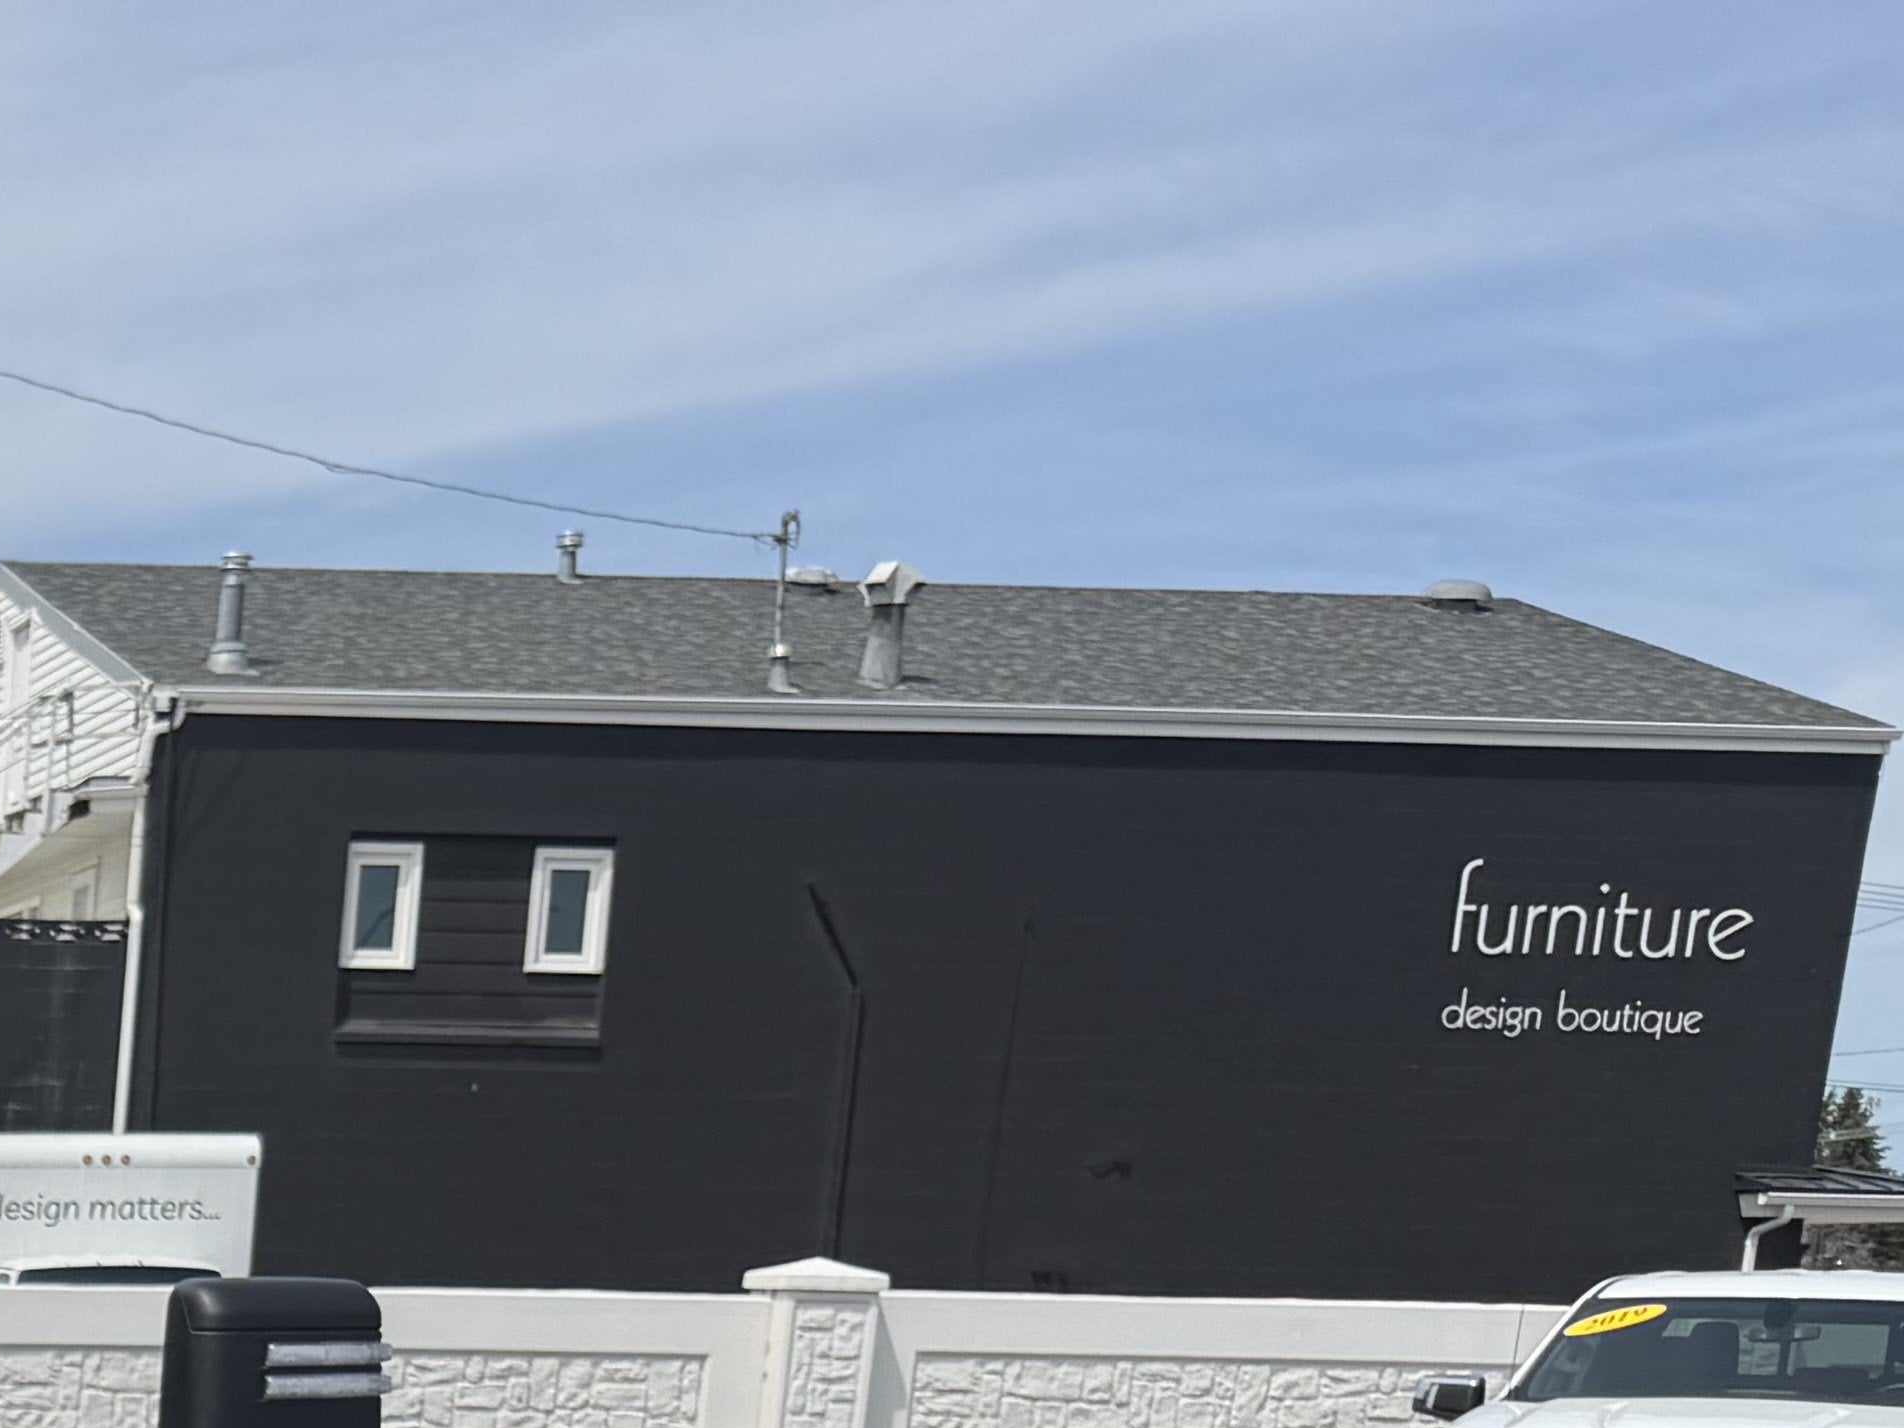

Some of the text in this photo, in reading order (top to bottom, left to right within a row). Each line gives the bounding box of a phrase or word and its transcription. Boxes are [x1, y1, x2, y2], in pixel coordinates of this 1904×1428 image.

[1449, 857, 1754, 961] furniture
[1440, 986, 1704, 1041] design boutique
[88, 1196, 223, 1222] matters...
